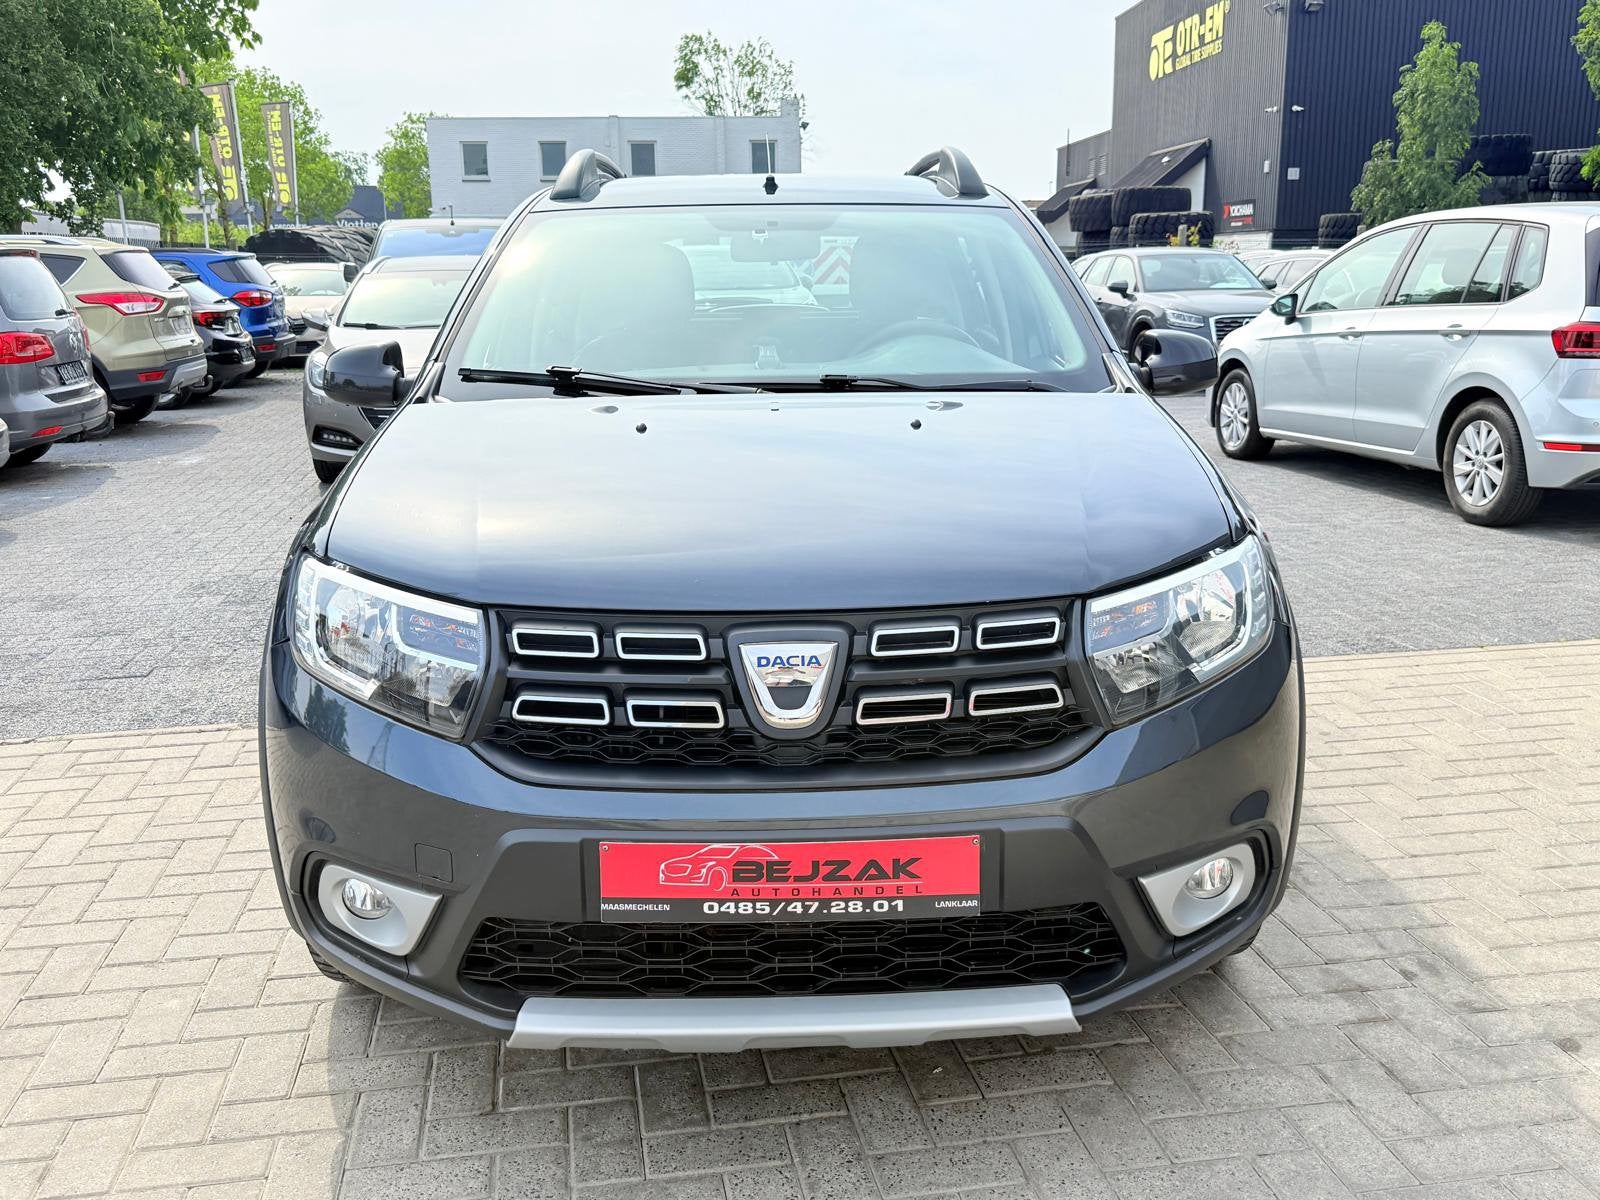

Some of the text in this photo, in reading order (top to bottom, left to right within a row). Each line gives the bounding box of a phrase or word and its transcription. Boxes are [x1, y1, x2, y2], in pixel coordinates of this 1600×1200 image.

[1176, 0, 1224, 56] OTR-EM
[757, 655, 821, 667] DACIA
[732, 858, 922, 882] BEJZAK
[731, 886, 922, 896] AUTOHANDEL
[601, 903, 670, 911] MAASMECHELEN
[703, 899, 904, 915] 0485/47.28.01
[935, 900, 978, 908] LANKLAAR
